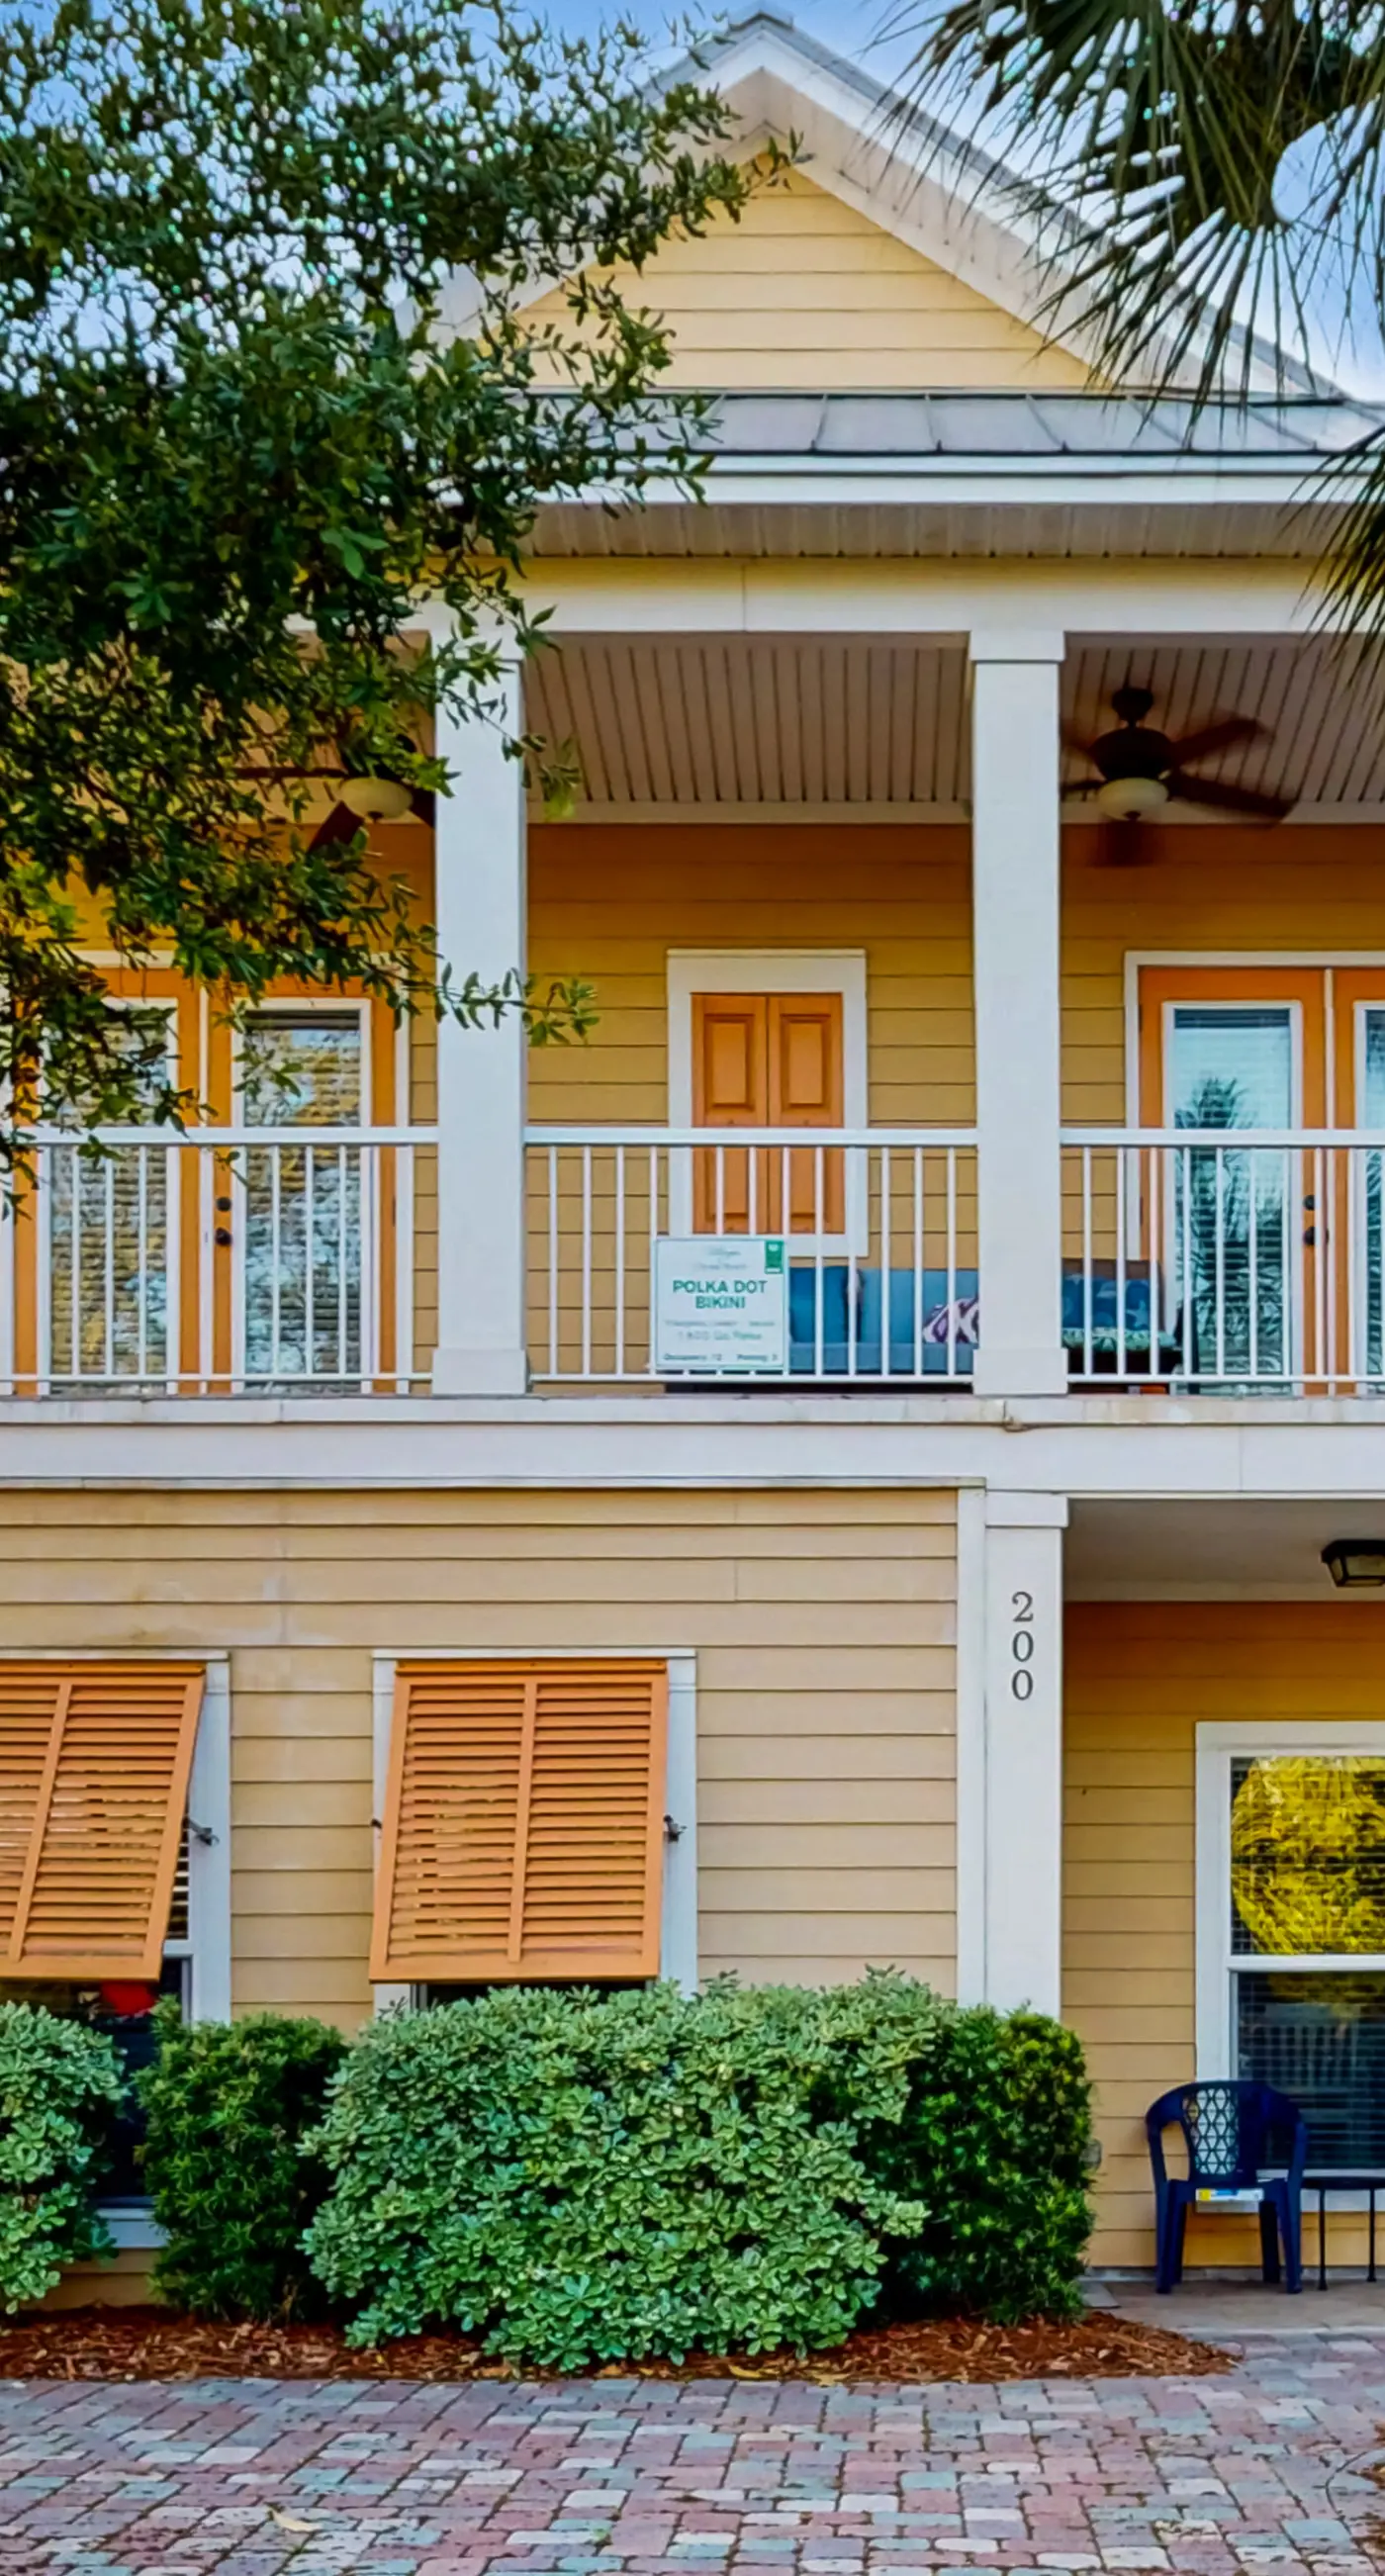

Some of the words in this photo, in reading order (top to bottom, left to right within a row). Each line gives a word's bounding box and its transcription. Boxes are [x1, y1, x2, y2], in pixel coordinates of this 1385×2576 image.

[673, 1280, 728, 1294] POLKA
[734, 1280, 768, 1293] DOT
[695, 1296, 746, 1309] BIKINI
[1011, 1591, 1034, 1702] 200
